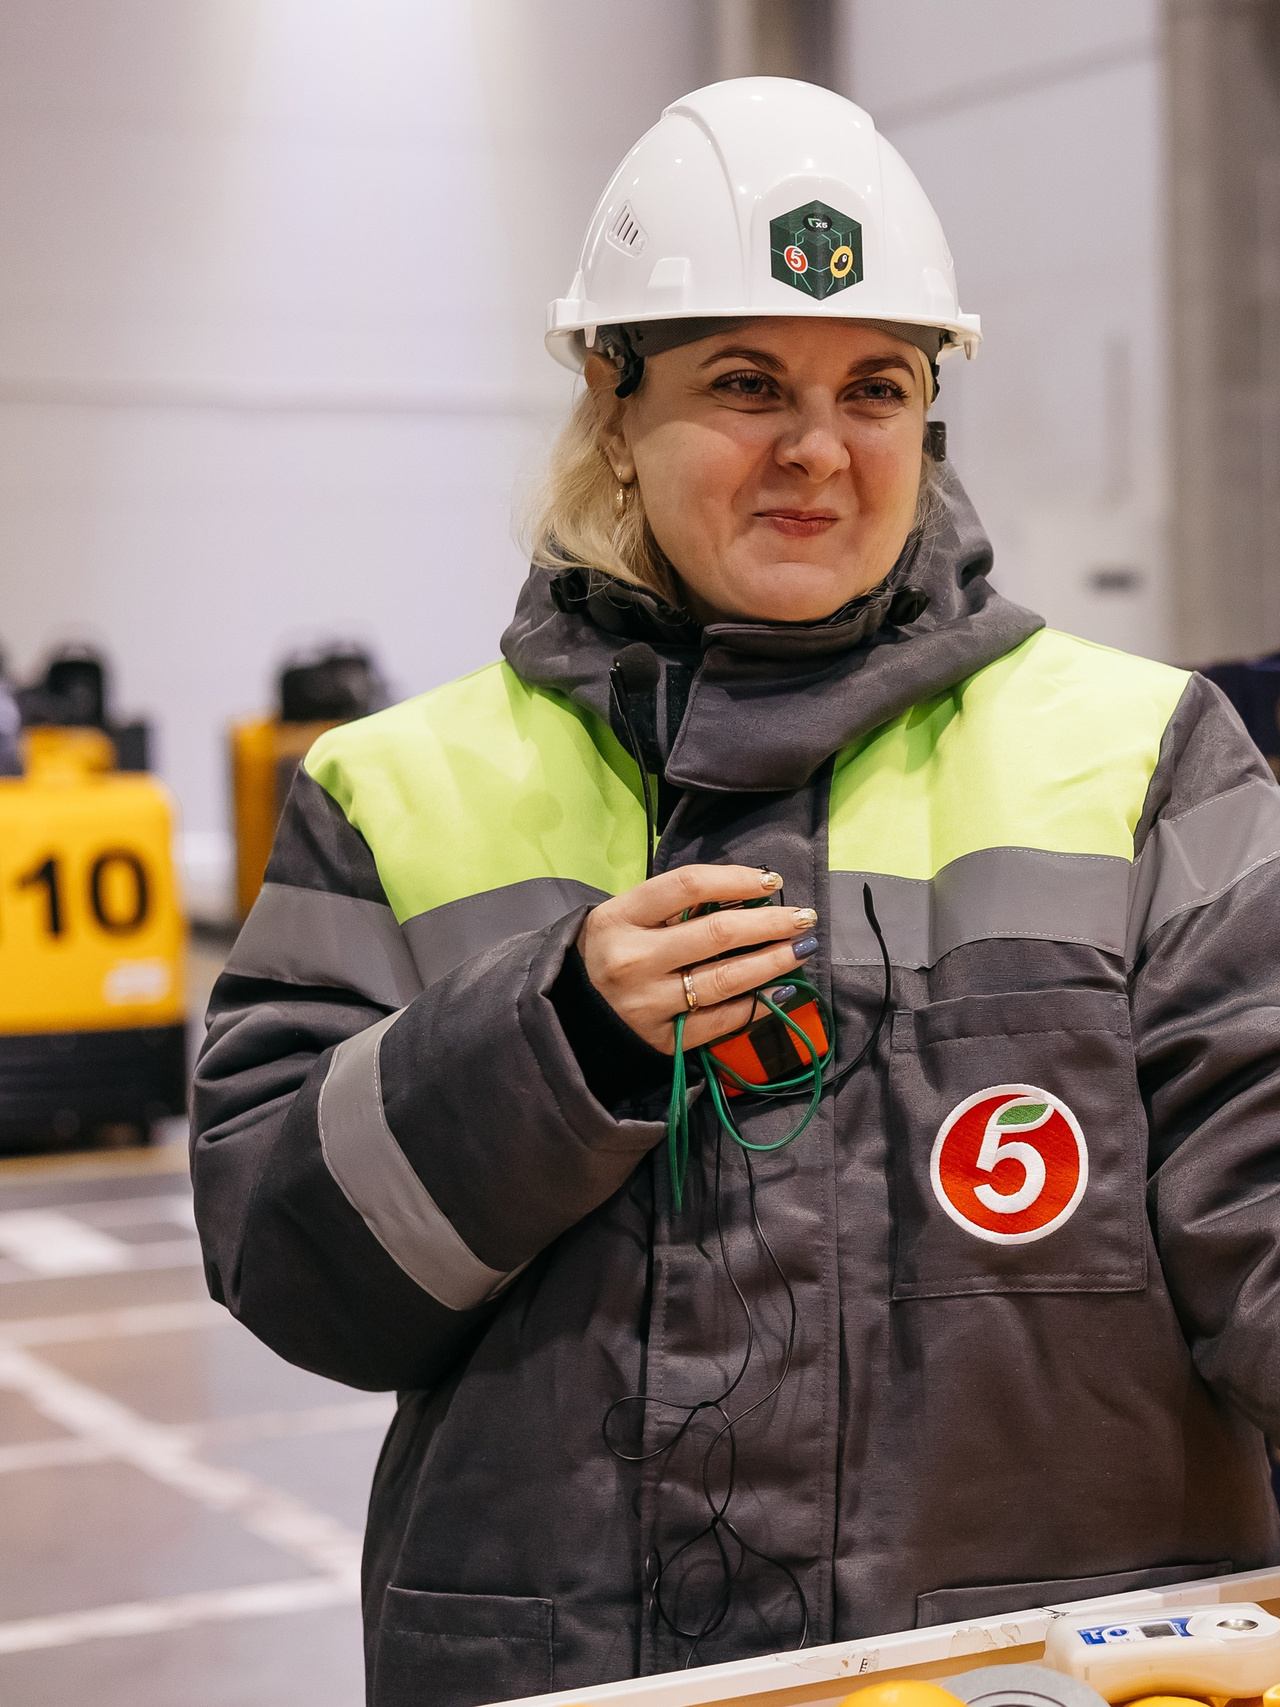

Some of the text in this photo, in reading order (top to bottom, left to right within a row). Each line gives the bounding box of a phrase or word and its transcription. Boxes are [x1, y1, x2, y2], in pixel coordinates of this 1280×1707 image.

[815, 221, 828, 229] X5
[13, 847, 153, 942] 10
[973, 1096, 1054, 1214] 5
